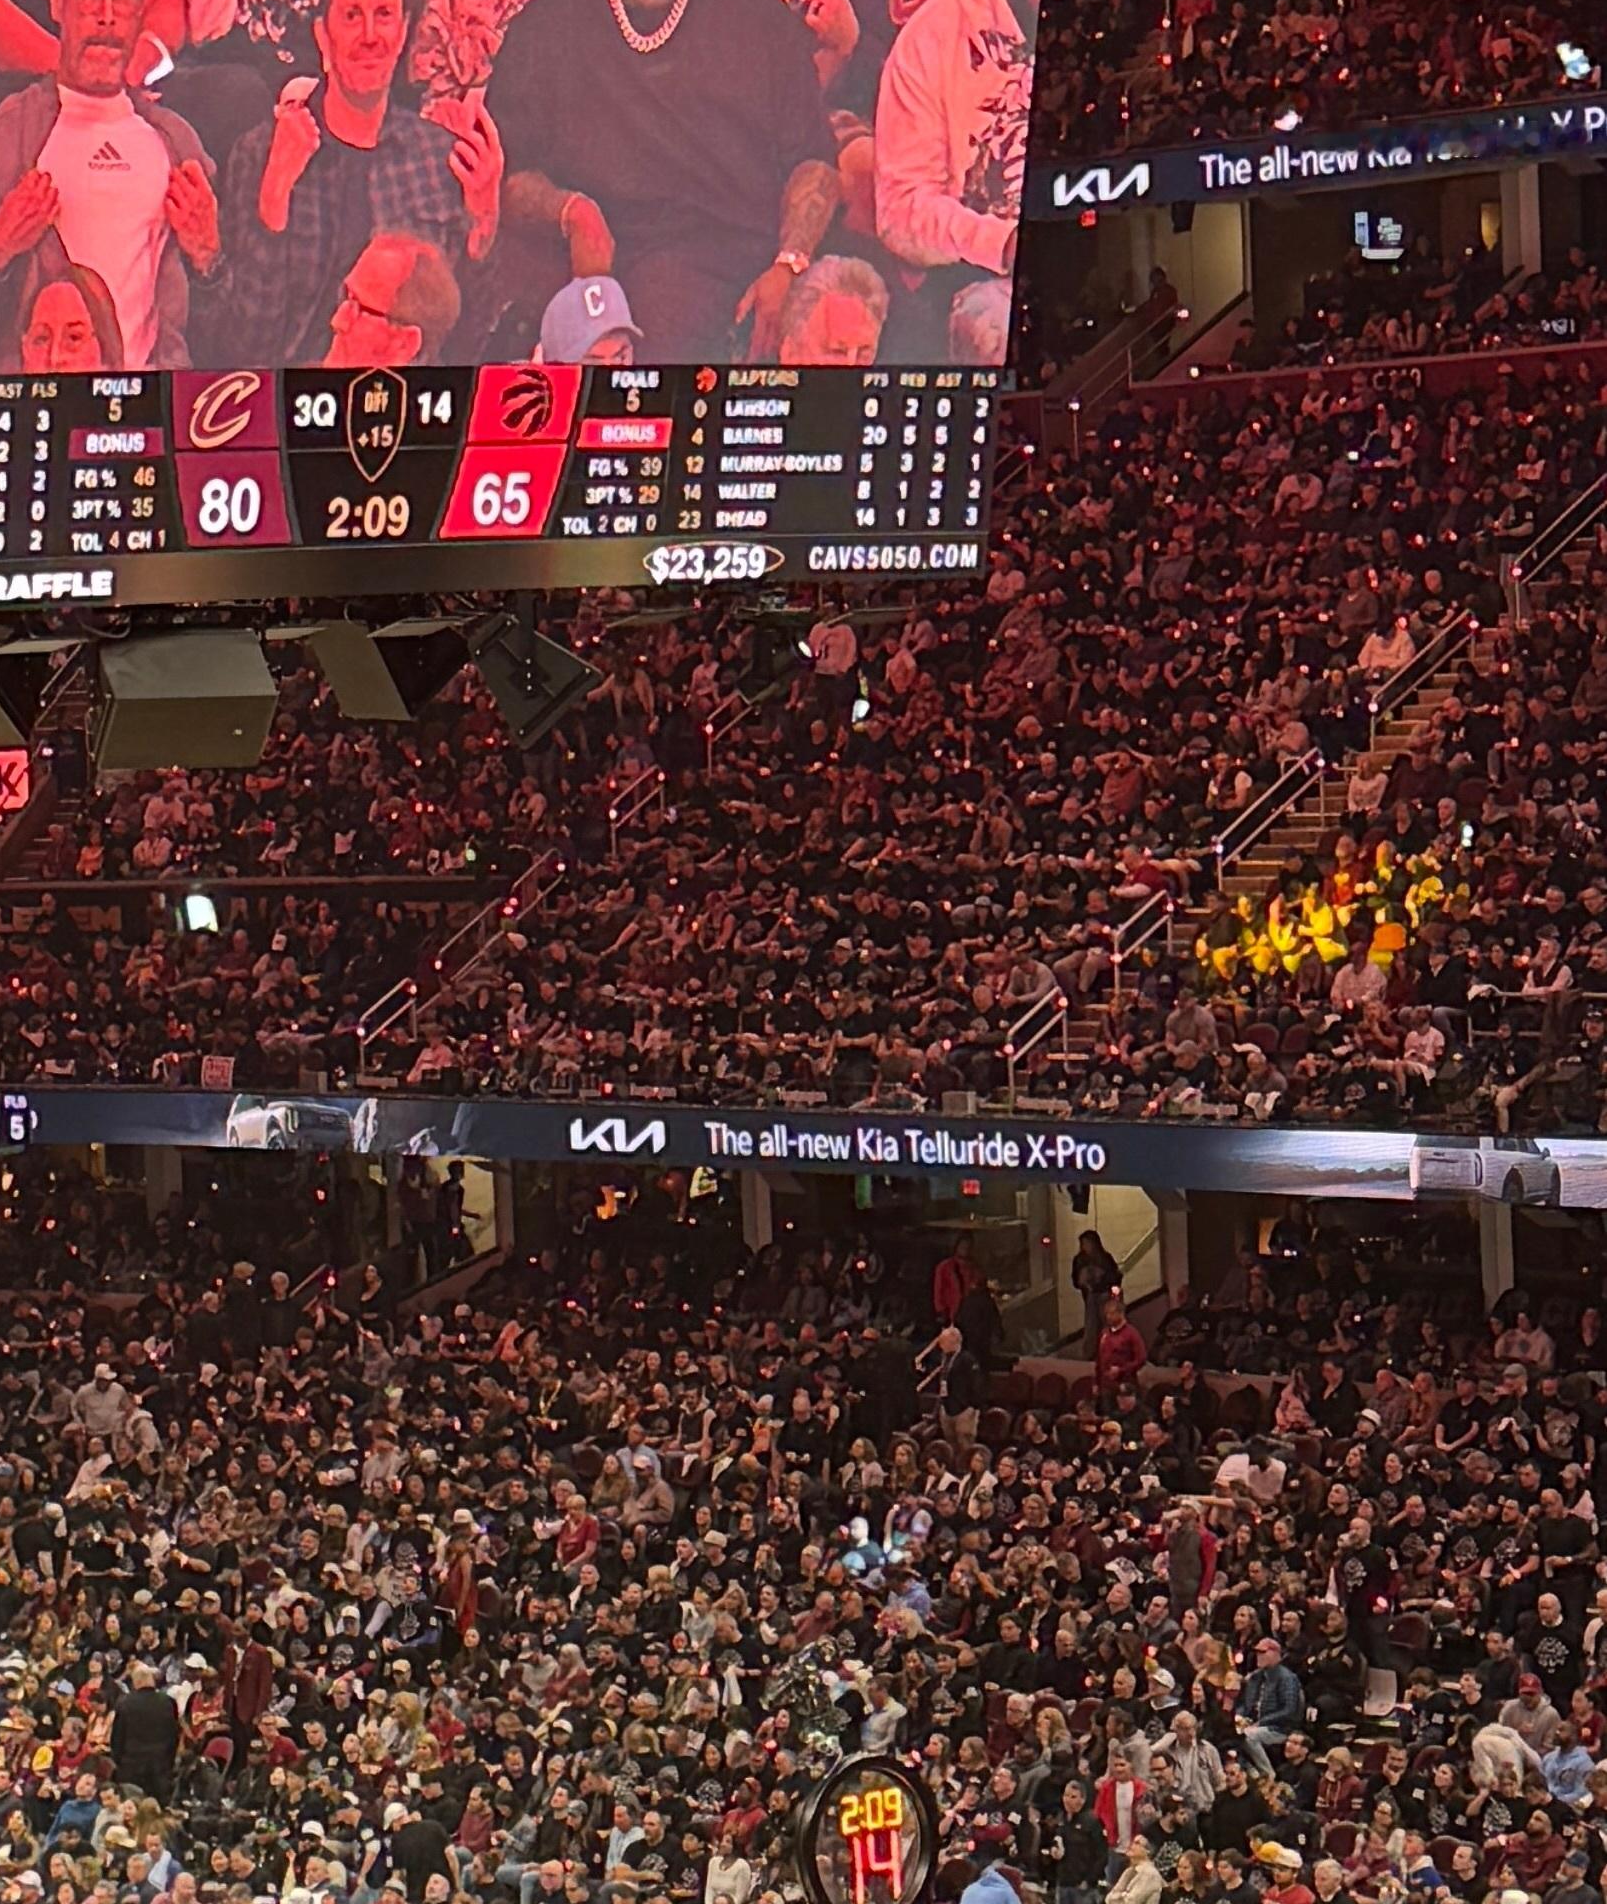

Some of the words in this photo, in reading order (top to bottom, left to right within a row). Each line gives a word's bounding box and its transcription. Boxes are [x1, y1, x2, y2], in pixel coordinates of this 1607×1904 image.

[1199, 154, 1251, 189] The
[1259, 147, 1358, 183] all-new
[93, 378, 142, 397] FOULS
[294, 394, 337, 427] 3Q
[417, 391, 453, 425] 14
[86, 429, 145, 453] BONUS
[358, 428, 394, 448] +15
[601, 424, 656, 444] BONUS
[134, 467, 156, 486] 46
[72, 500, 103, 520] 3PT
[132, 497, 154, 518] 35
[198, 477, 261, 534] 80
[472, 472, 531, 526] 65
[326, 495, 410, 539] 2:09
[679, 510, 701, 529] 23
[72, 533, 103, 552] TOL
[128, 531, 152, 550] CH
[651, 547, 767, 586] $23,259
[809, 544, 978, 571] CAVS5050.COM
[10, 1113, 26, 1140] 5
[706, 1122, 753, 1158] The
[759, 1124, 850, 1162] all-new
[857, 1128, 899, 1163] Kia
[904, 1129, 1019, 1168] Telluride
[1027, 1134, 1105, 1172] X-Pro
[840, 1786, 904, 1836] 2:09
